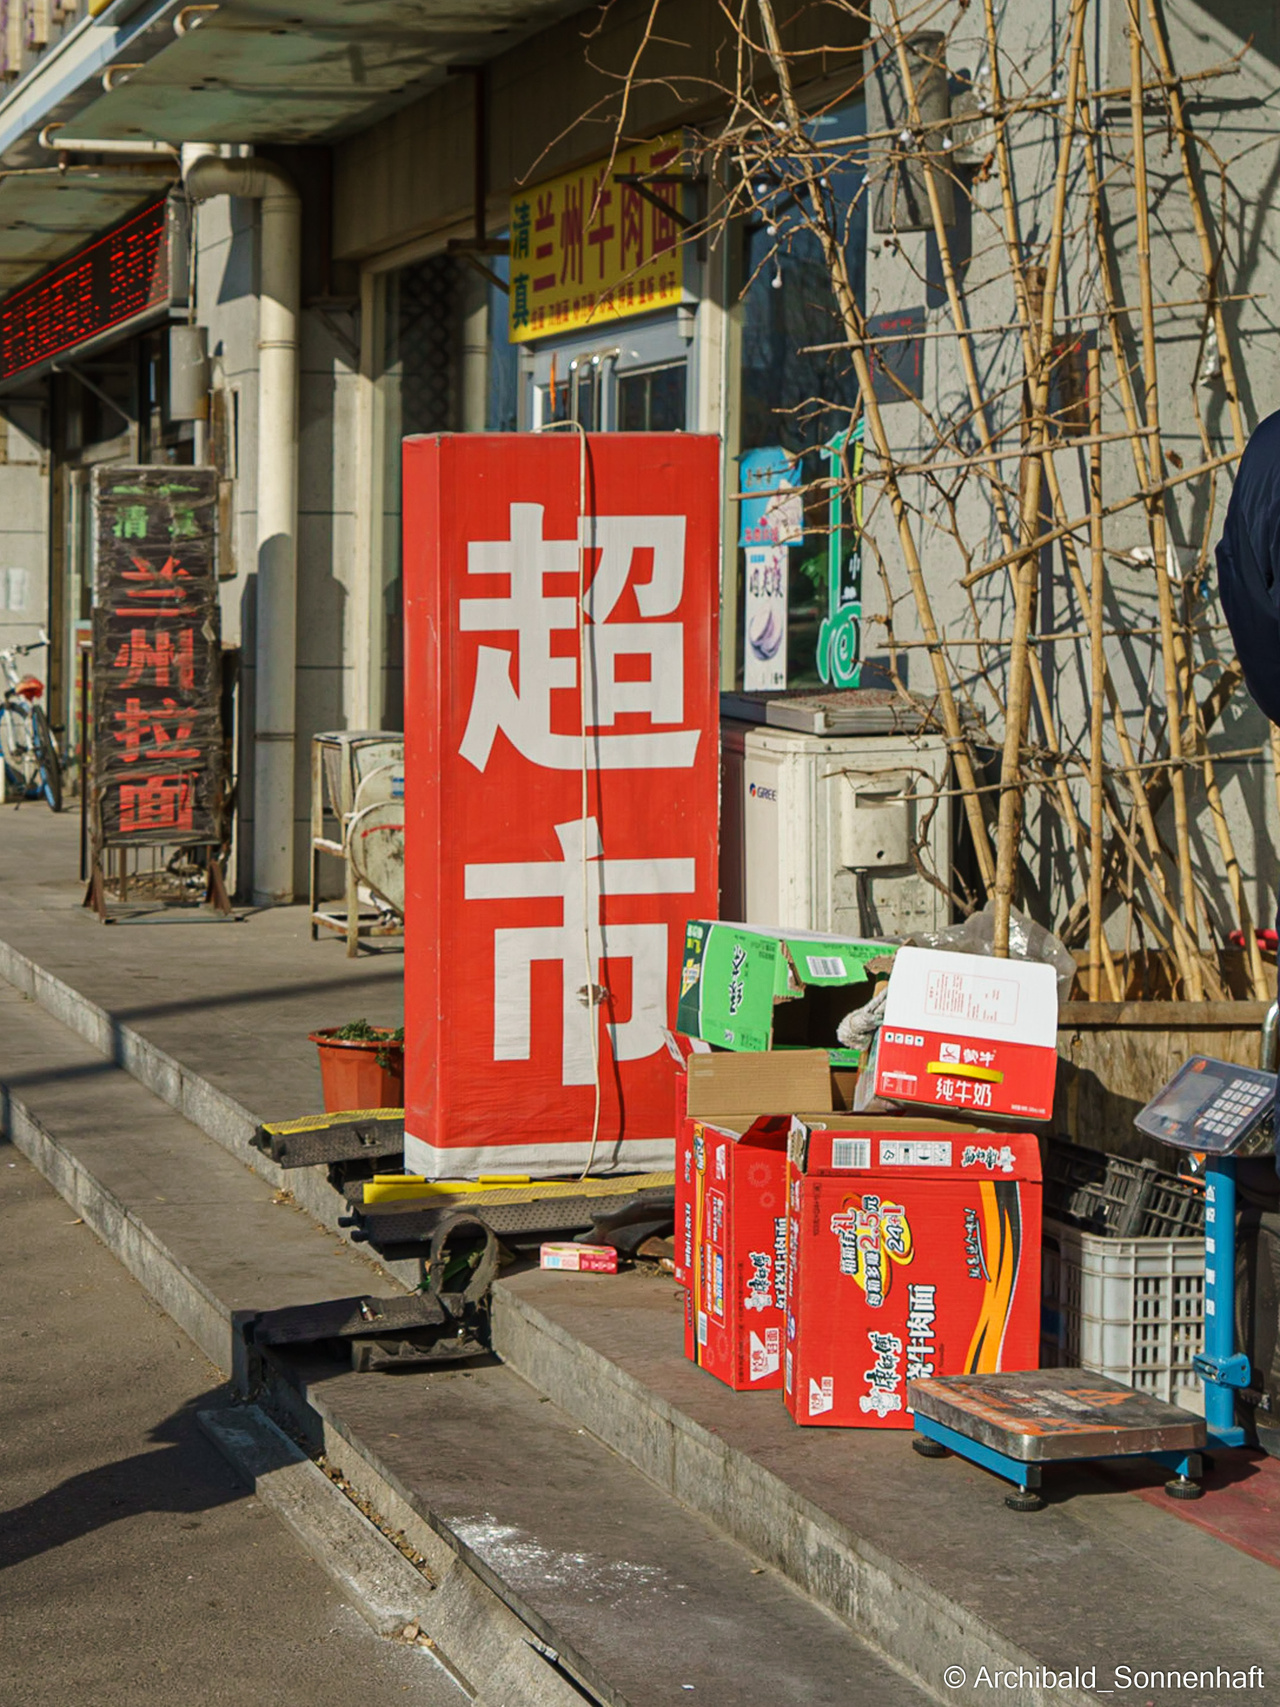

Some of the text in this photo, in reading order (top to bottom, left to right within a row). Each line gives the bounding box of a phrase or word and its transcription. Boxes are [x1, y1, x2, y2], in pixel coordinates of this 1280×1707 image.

[533, 147, 680, 293] 兰州牛肉面
[513, 200, 531, 330] 清真
[114, 556, 201, 832] 兰州拉面
[459, 503, 702, 1087] 超市
[757, 786, 778, 801] GREE
[935, 1077, 992, 1107] 纯牛奶
[963, 1048, 996, 1067] 蒙牛
[881, 1206, 905, 1254] 24+1
[766, 1329, 779, 1355] 好面
[906, 1283, 937, 1386] 烧牛肉面
